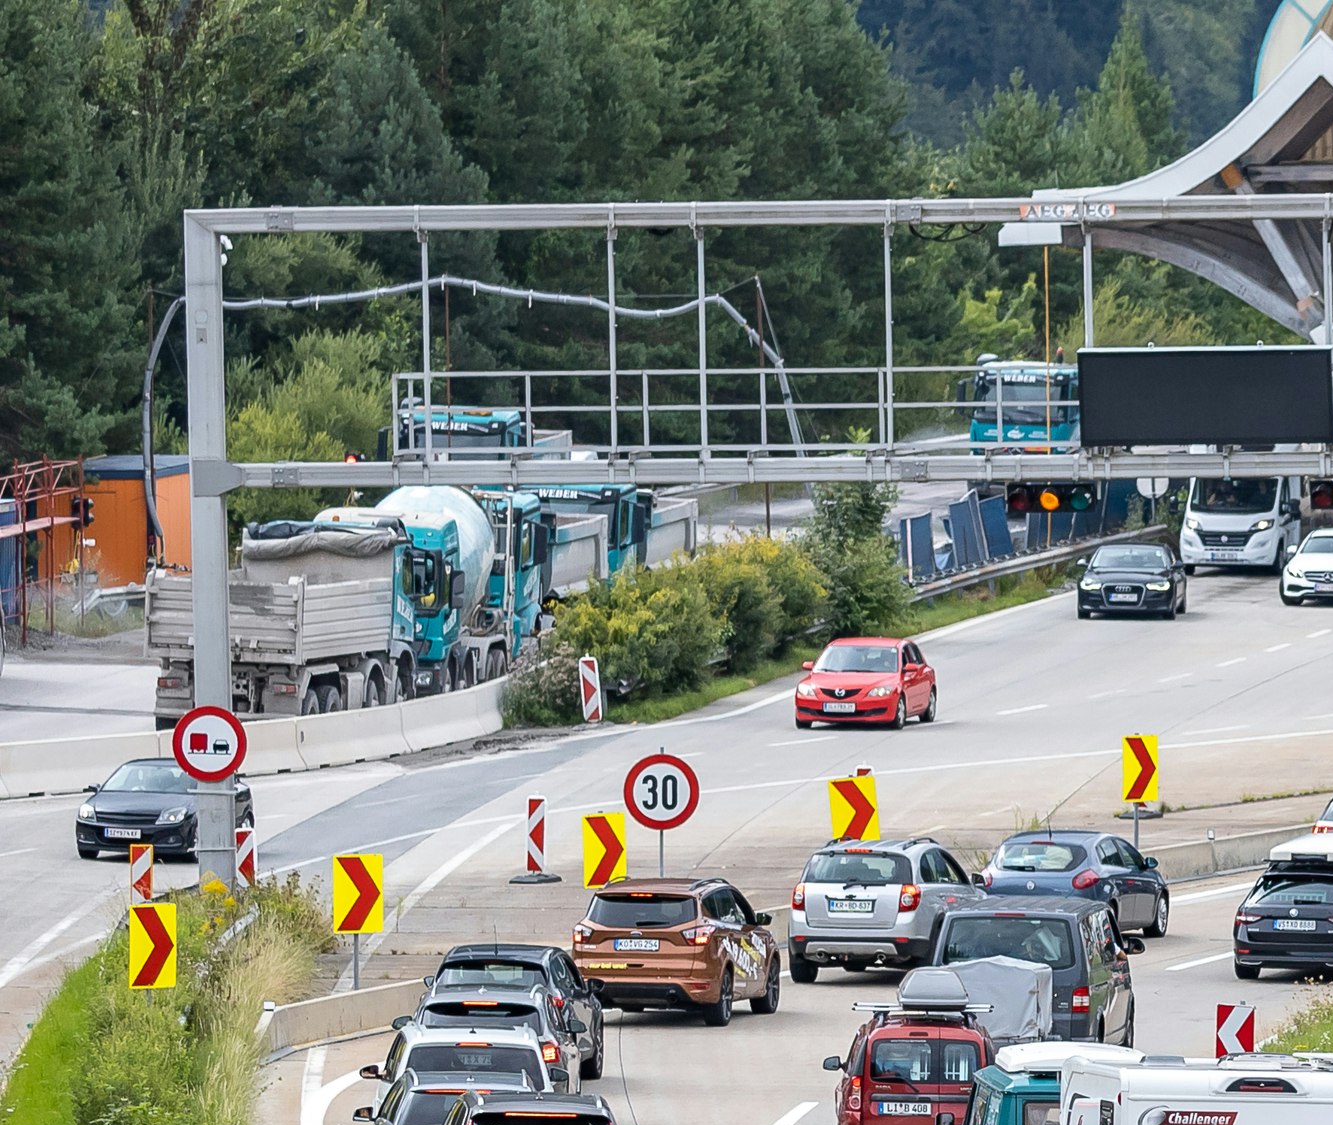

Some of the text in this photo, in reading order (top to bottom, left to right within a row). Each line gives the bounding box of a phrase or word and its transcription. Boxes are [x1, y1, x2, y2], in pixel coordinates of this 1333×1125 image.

[538, 488, 578, 499] WEBER
[642, 775, 678, 810] 30
[887, 1103, 898, 1112] LI
[912, 1103, 928, 1113] 408
